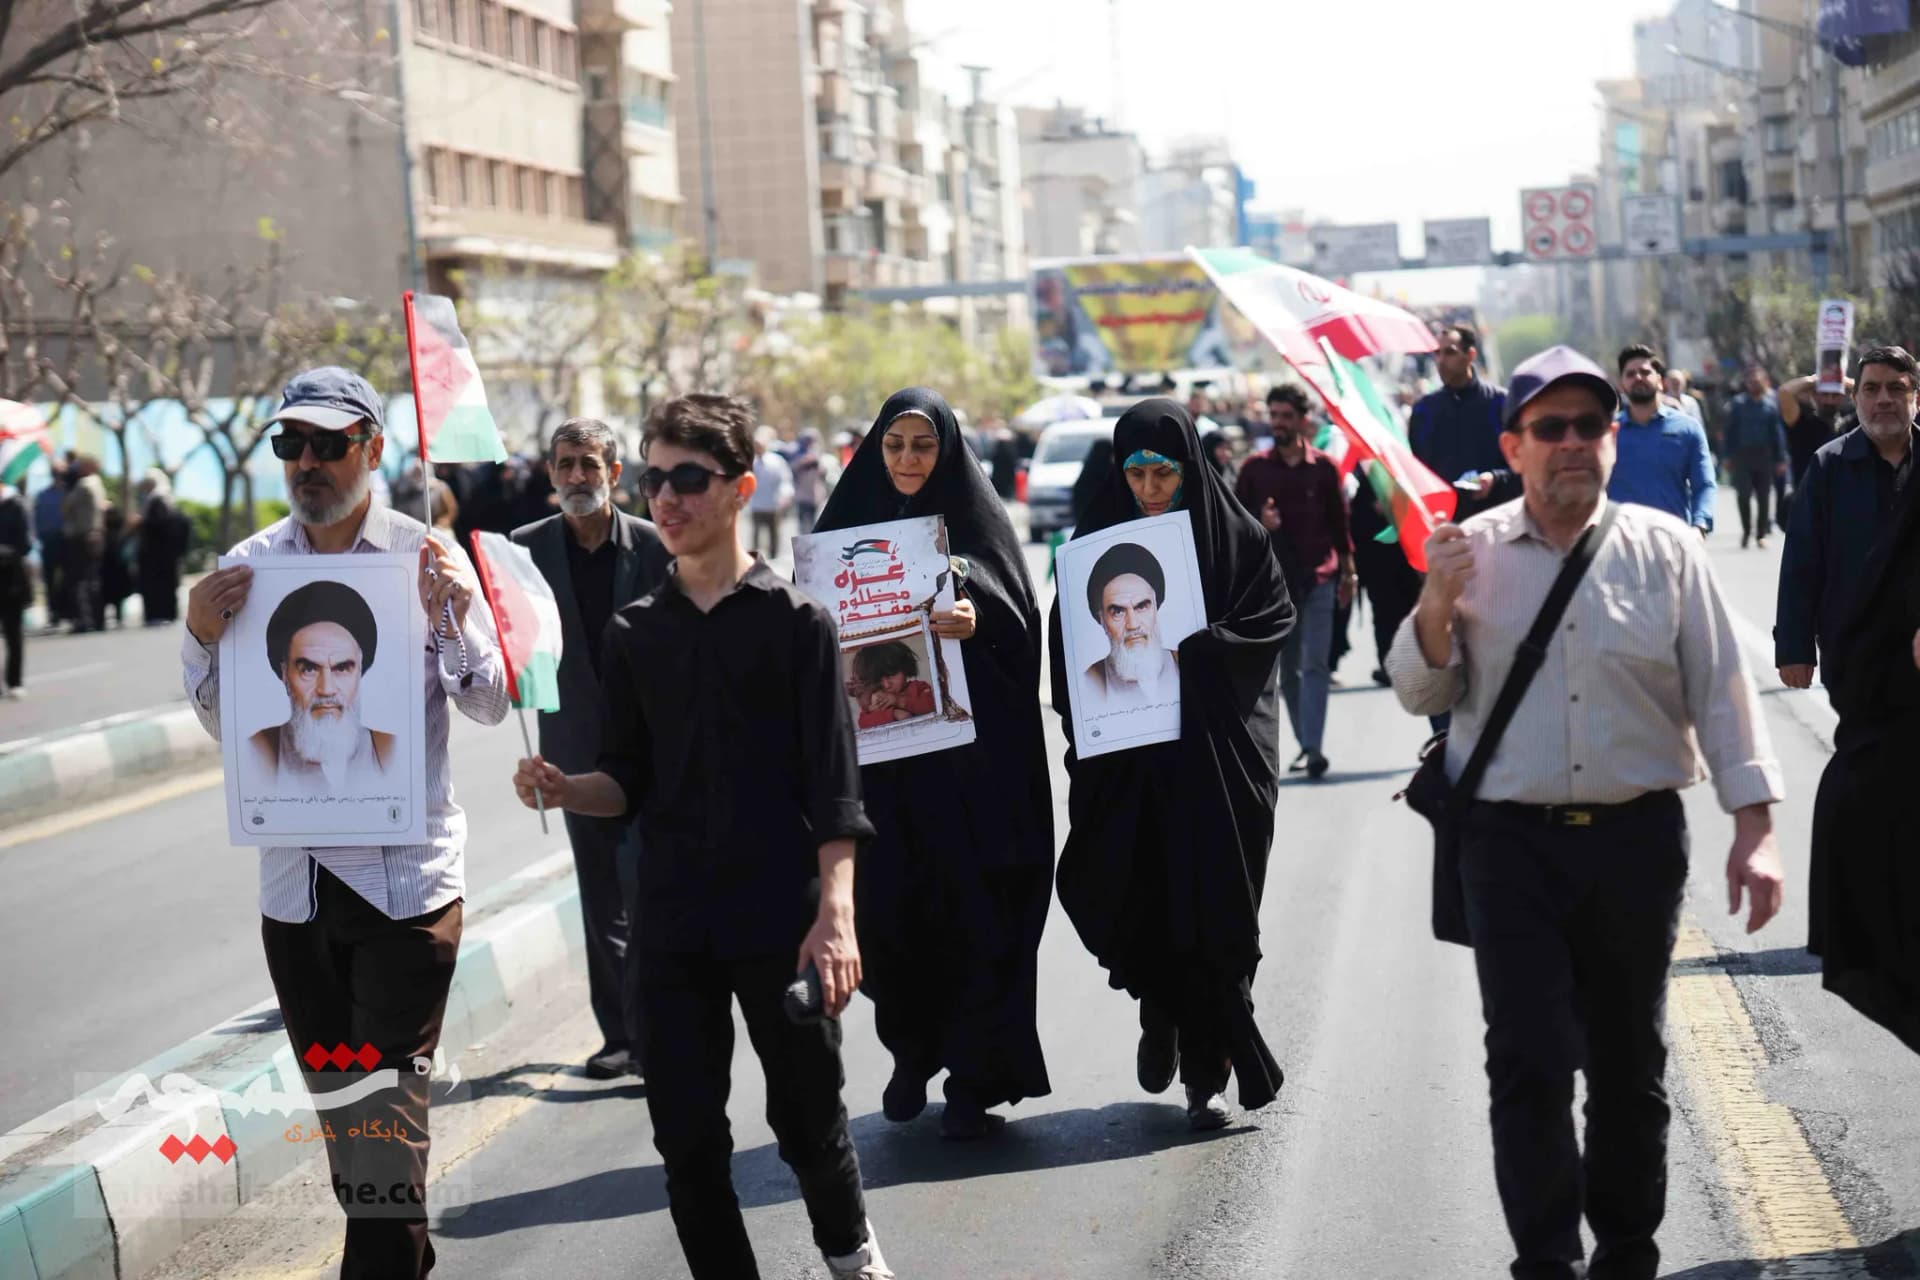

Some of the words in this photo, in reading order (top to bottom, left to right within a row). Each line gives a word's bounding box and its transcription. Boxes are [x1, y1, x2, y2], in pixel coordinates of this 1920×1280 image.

[834, 552, 905, 593] غزه
[839, 588, 910, 611] مظلوم
[841, 601, 912, 626] مقتدر
